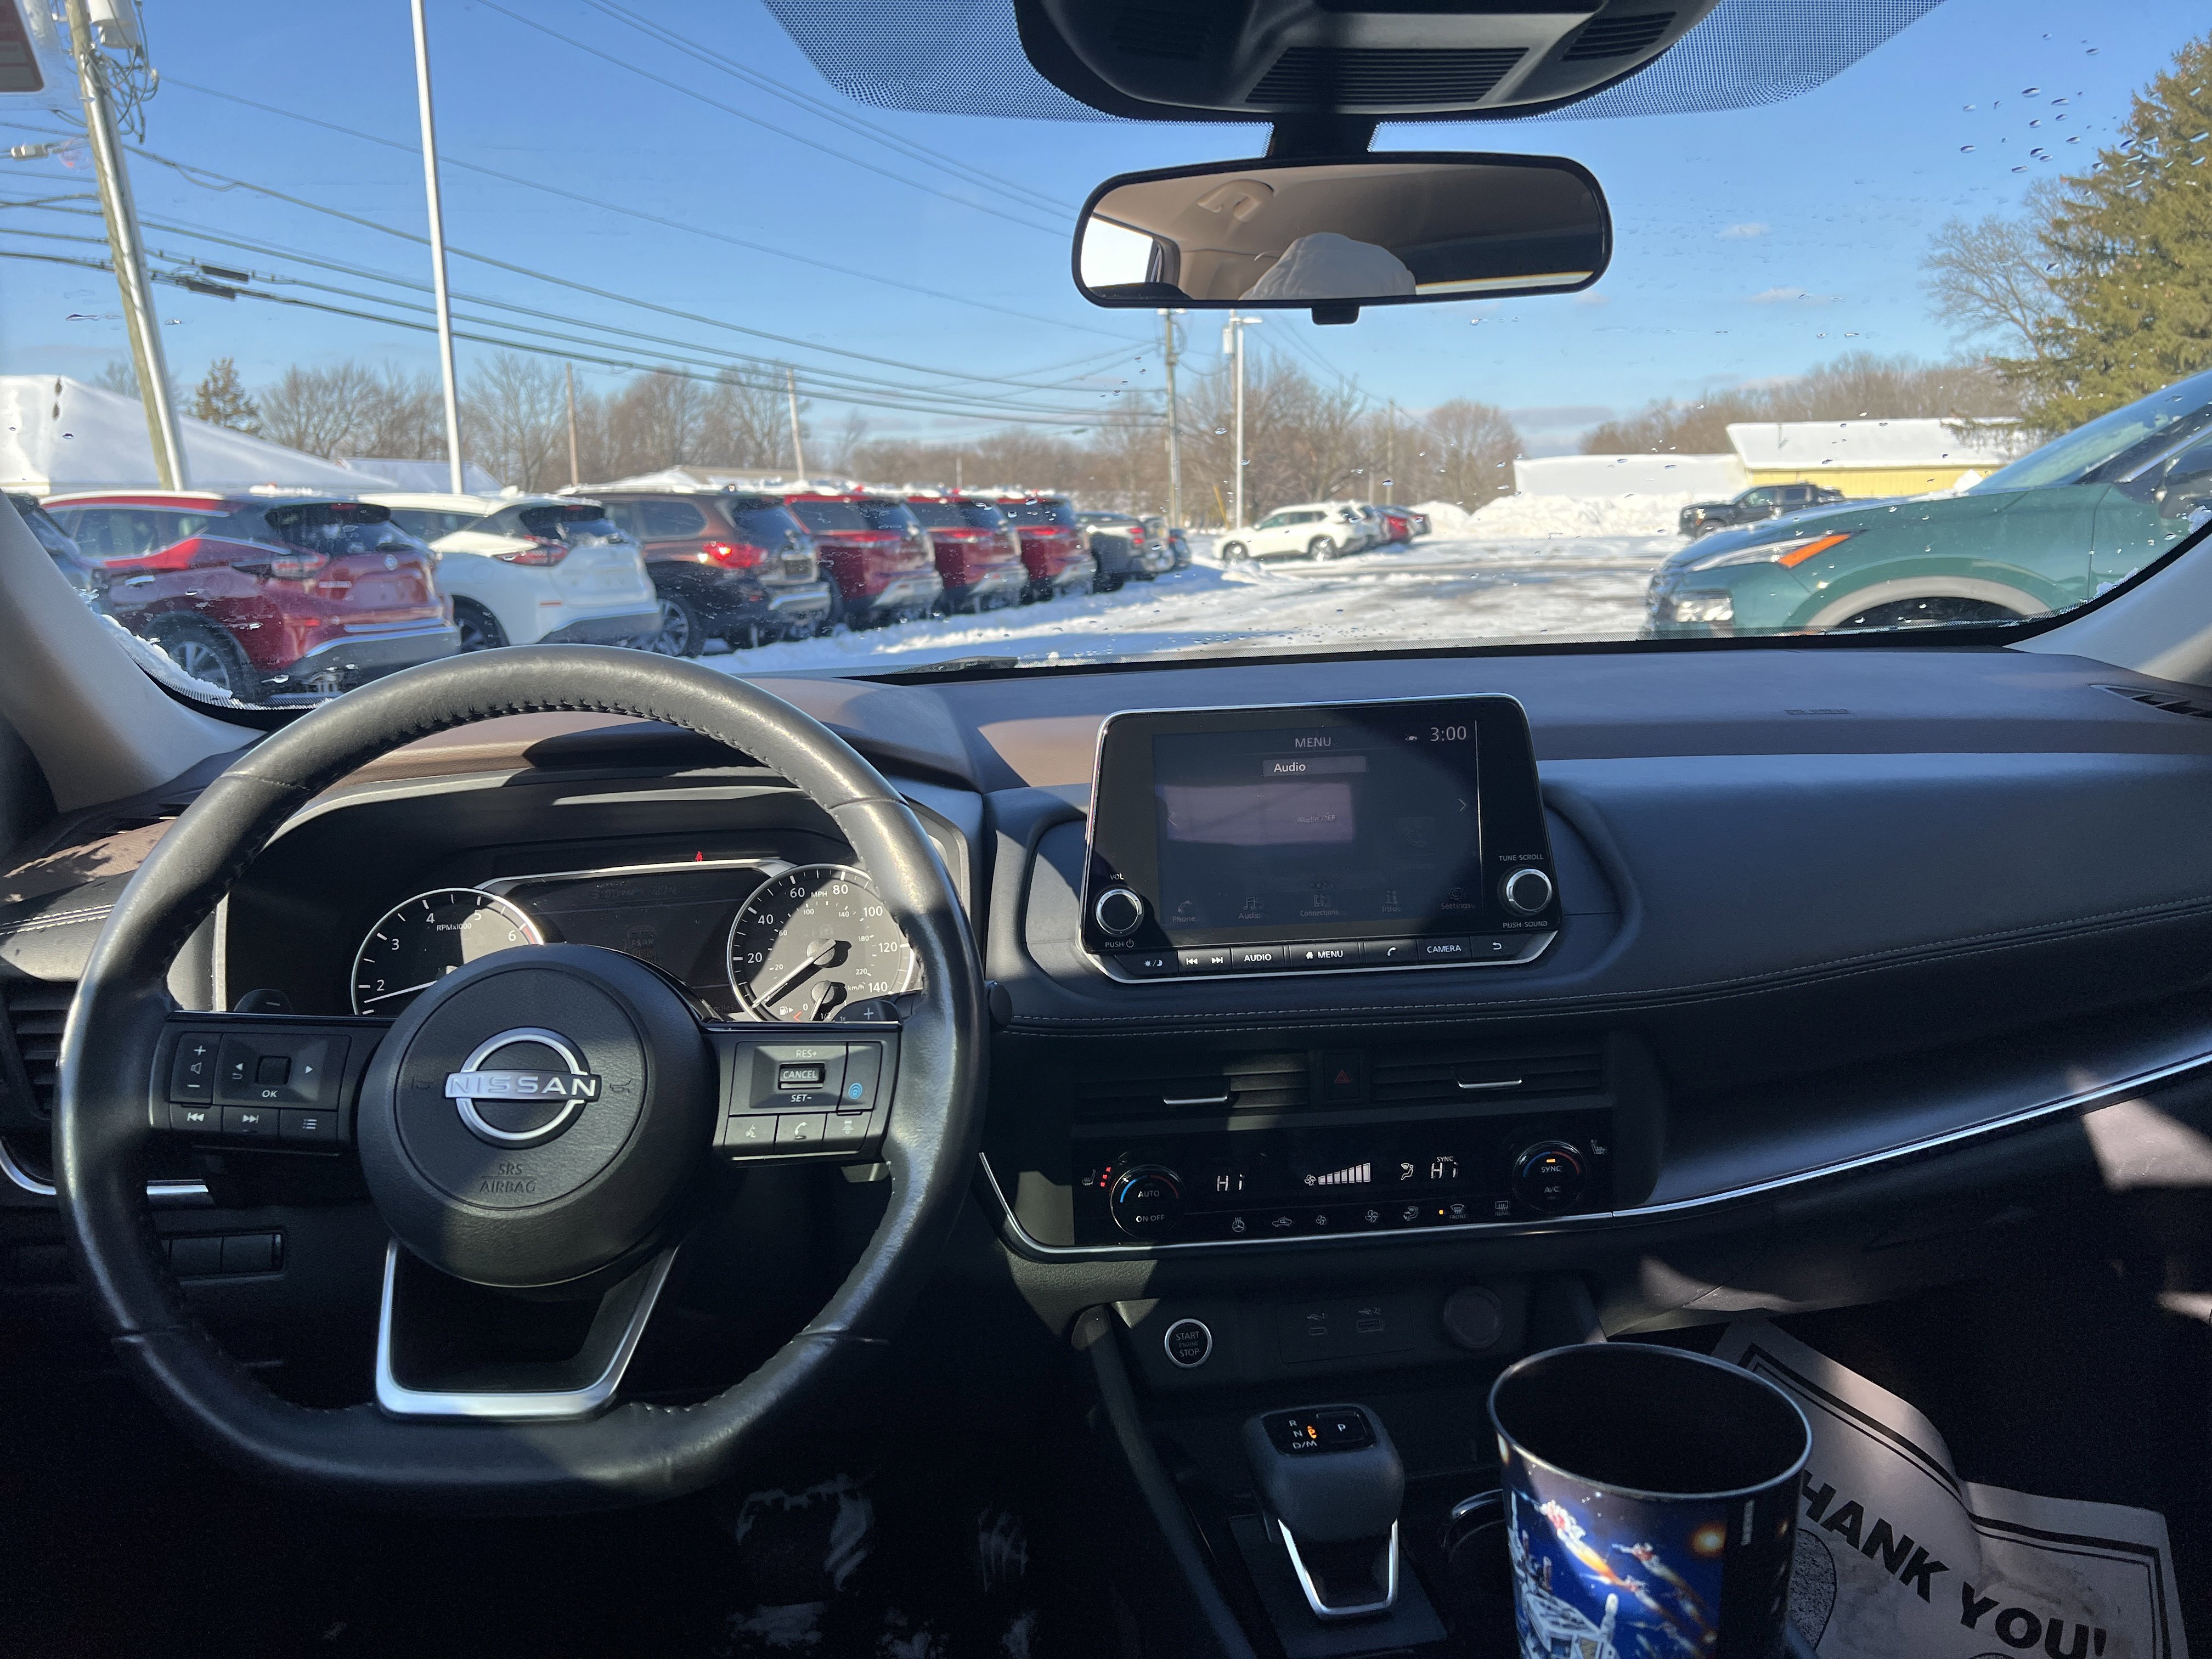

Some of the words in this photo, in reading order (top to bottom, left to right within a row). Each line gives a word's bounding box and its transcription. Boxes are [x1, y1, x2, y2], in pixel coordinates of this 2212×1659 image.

[1430, 725, 1467, 742] 3:00
[1295, 736, 1331, 748] MENU
[1273, 761, 1306, 772] Audio
[790, 887, 805, 898] 60
[833, 884, 849, 895] 80
[863, 906, 883, 917] 100
[1441, 902, 1471, 911] Settings
[426, 912, 435, 923] 4
[474, 910, 482, 921] 5
[1300, 909, 1339, 917] Connections
[758, 914, 774, 925] 40
[436, 923, 472, 932] RPMx1000
[508, 930, 516, 941] 6
[391, 938, 400, 950] 3
[878, 941, 898, 953] 120
[1426, 945, 1462, 954] CAMERA
[747, 952, 763, 963] 20
[1244, 953, 1272, 962] AUDIO
[1317, 950, 1344, 959] MENU
[376, 979, 385, 991] 2
[868, 981, 888, 993] 140
[783, 1070, 817, 1079] CANCEL
[450, 1076, 596, 1097] NISSAN
[262, 1090, 278, 1098] OK
[498, 1163, 523, 1176] SRS
[479, 1180, 536, 1193] AIRBAG
[1138, 1189, 1160, 1198] AUTO
[1176, 1331, 1200, 1341] START
[1180, 1348, 1200, 1357] STOP
[1292, 1440, 1317, 1449] D/M
[1801, 1469, 1950, 1603] HANK
